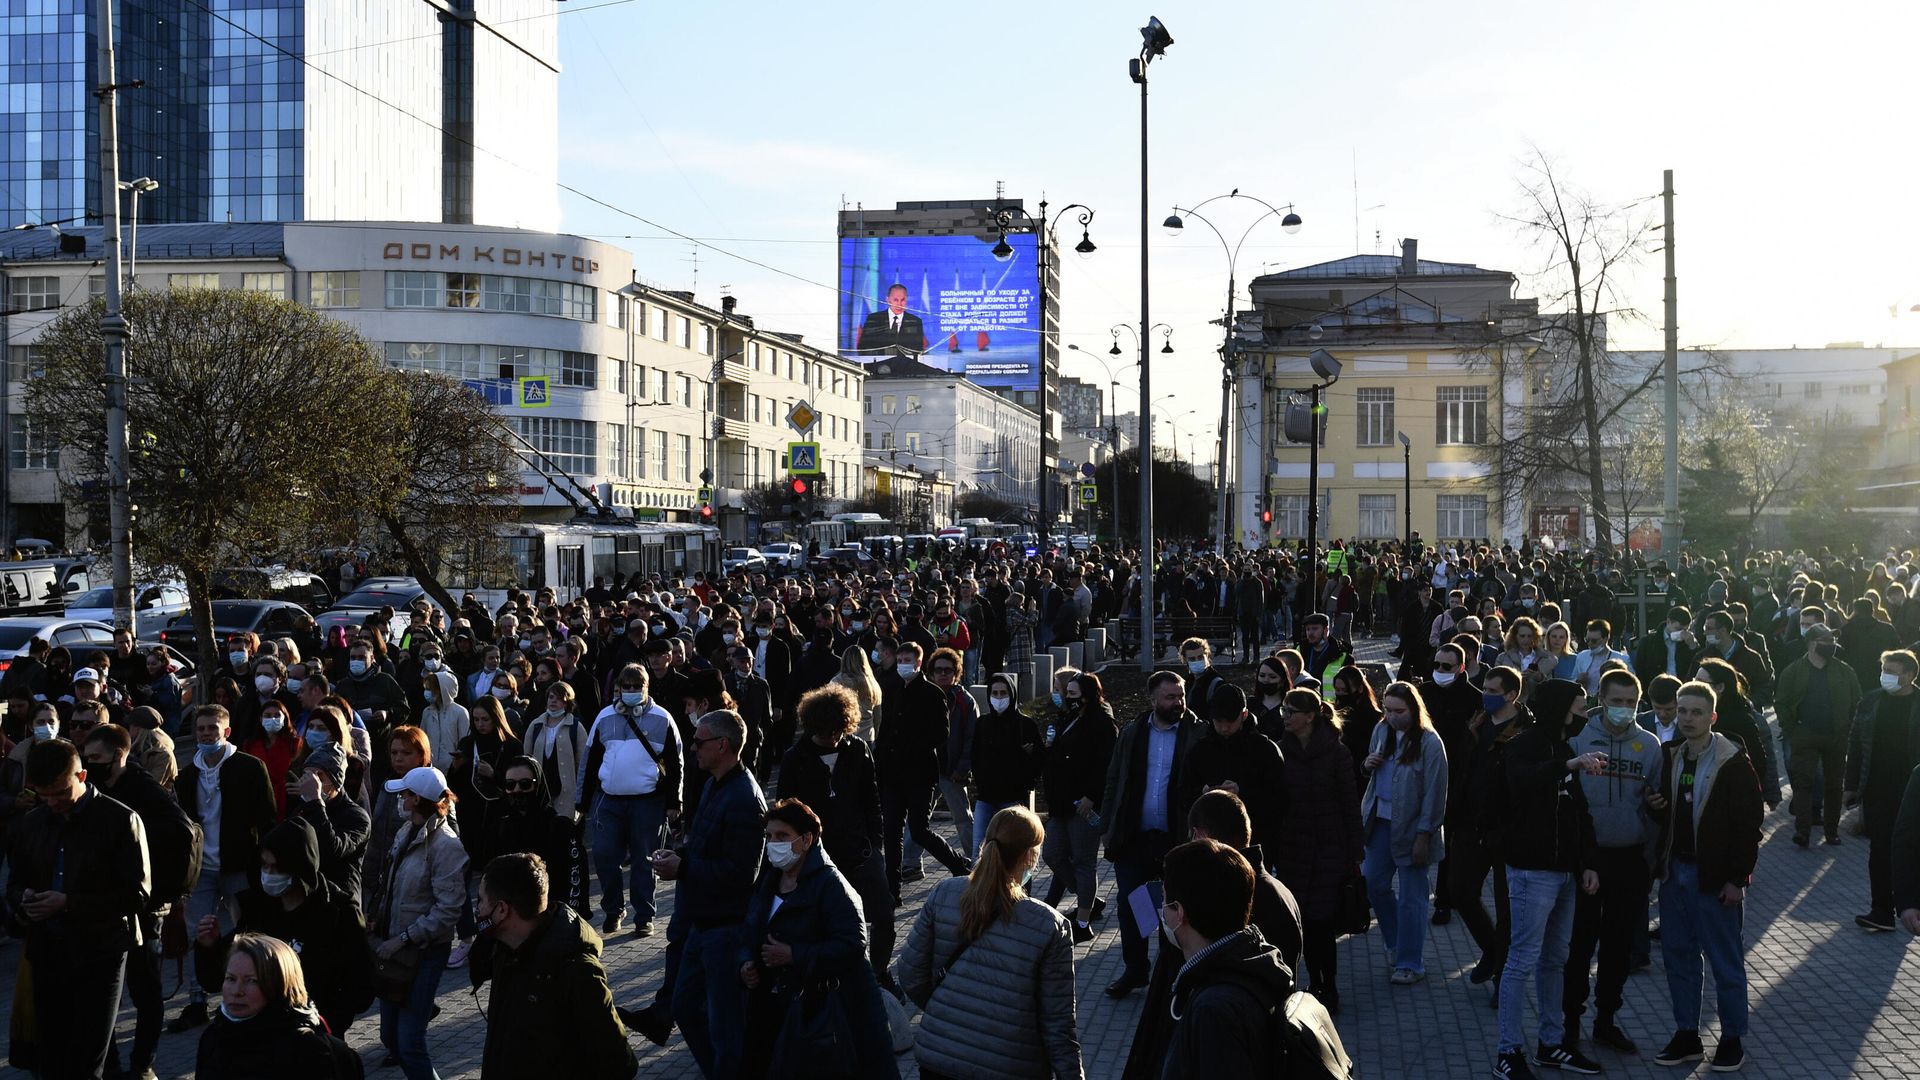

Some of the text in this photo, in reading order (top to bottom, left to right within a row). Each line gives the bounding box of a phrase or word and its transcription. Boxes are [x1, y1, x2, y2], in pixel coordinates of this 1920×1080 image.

[383, 243, 599, 274] ДОМ КОНТОР
[940, 289, 984, 297] БОЛЬНИЧНЫЙ
